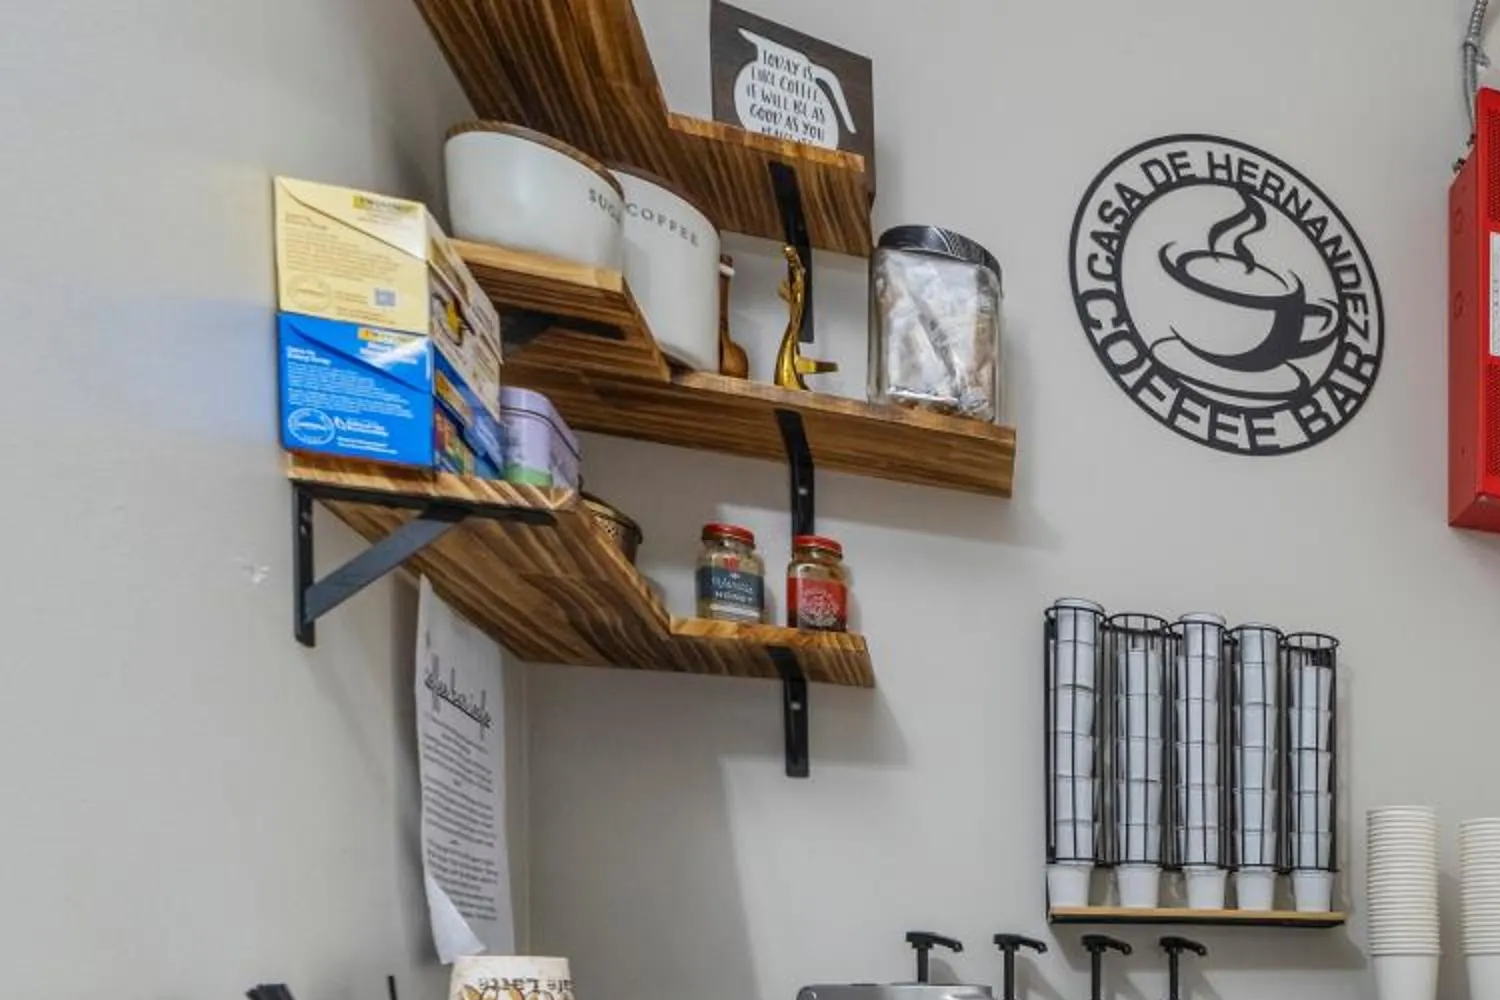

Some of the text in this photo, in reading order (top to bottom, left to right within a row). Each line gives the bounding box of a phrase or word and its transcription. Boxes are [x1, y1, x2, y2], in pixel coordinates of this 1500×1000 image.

[803, 65, 814, 82] IS
[749, 103, 783, 125] GOOD
[784, 115, 799, 133] AS
[802, 121, 825, 142] YOU
[761, 88, 788, 111] WILL
[811, 107, 826, 124] AS
[626, 203, 699, 247] COFFEE
[1086, 150, 1370, 341] CASA DE HERNANDEZ
[1078, 288, 1378, 449] COFFEE BAR
